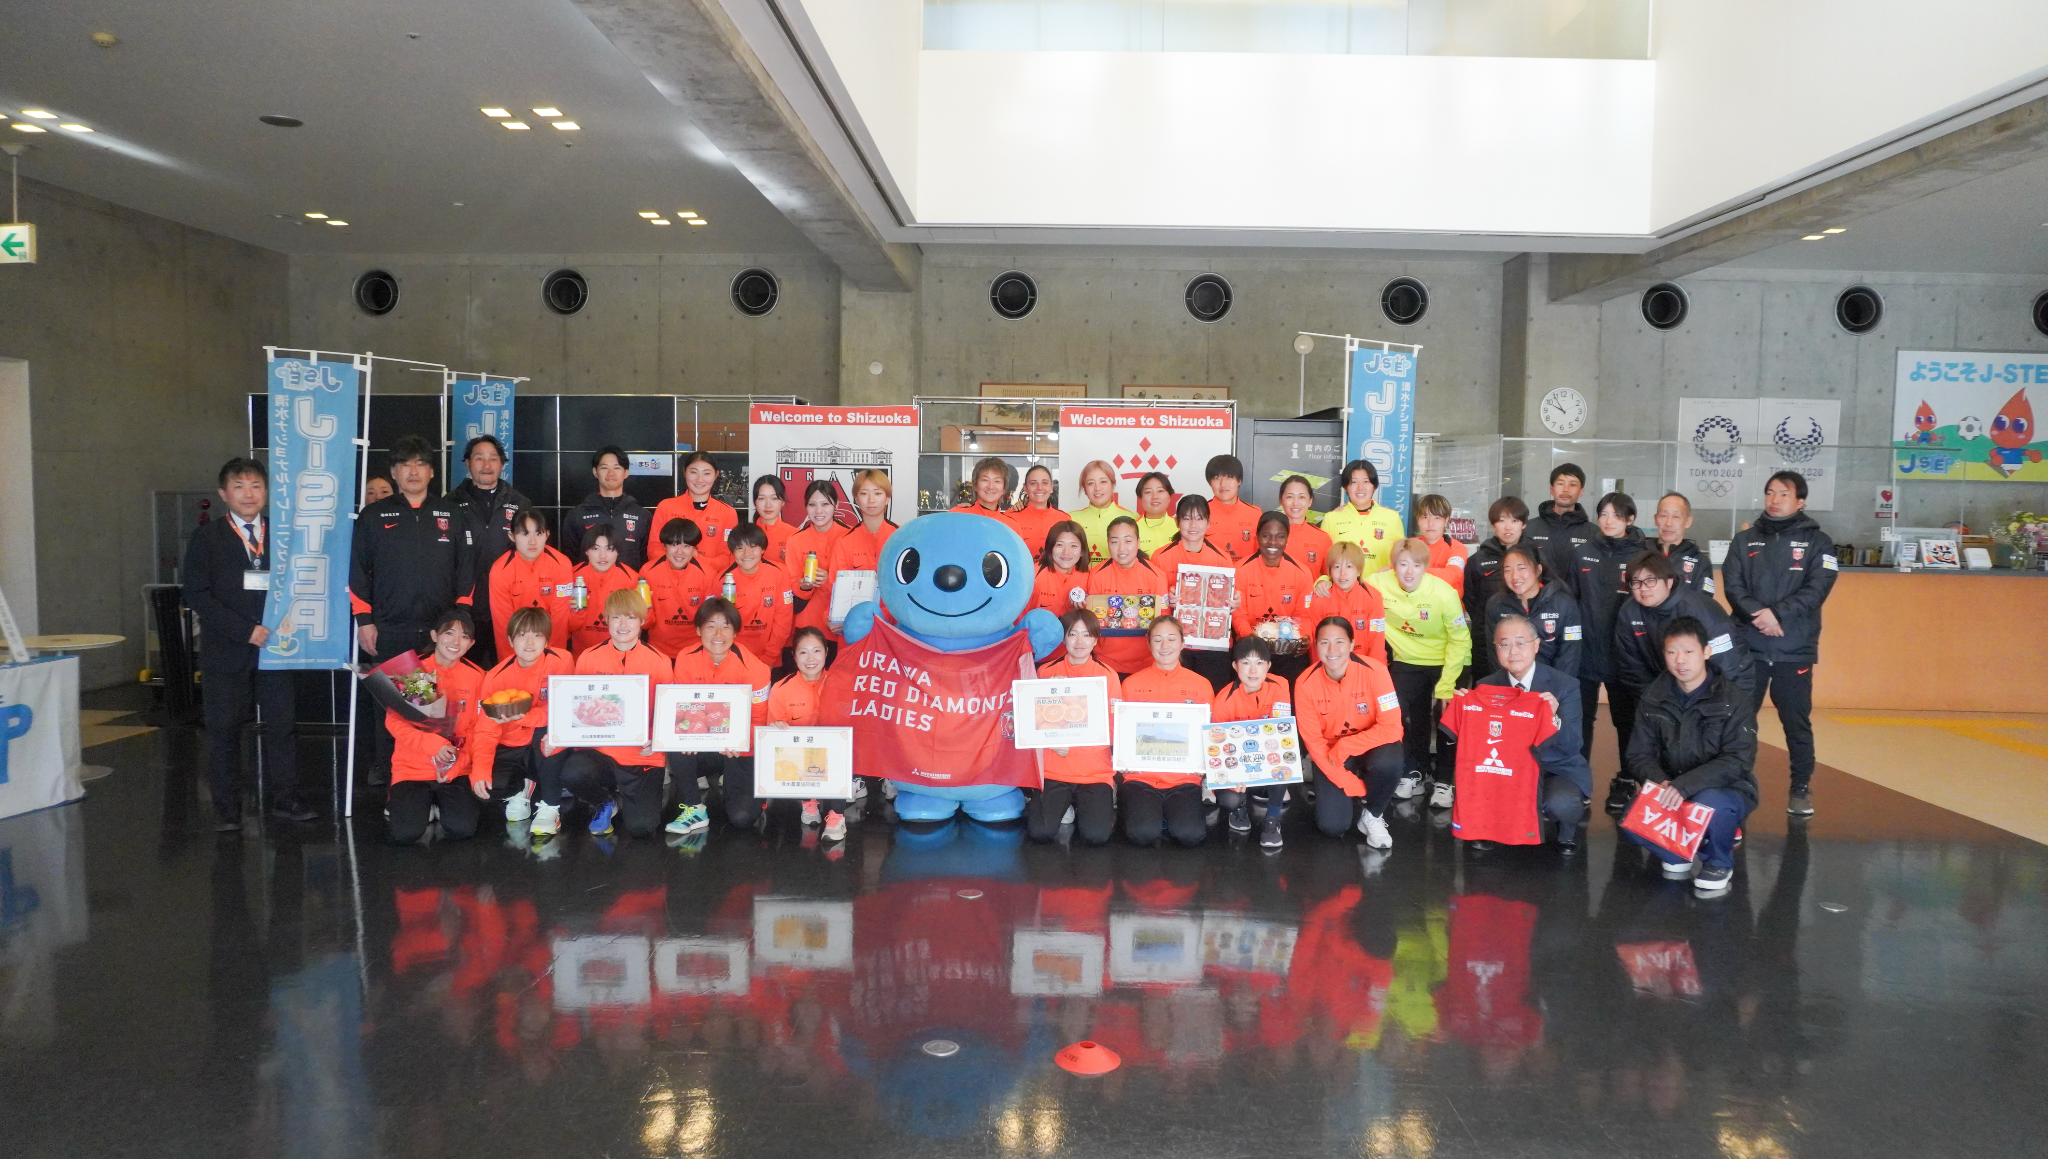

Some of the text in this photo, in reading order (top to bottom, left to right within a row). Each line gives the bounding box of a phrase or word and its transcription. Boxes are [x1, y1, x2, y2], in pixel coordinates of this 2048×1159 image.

[759, 410, 911, 424] Welcome to Shizuoka
[1070, 413, 1224, 427] Welcome to Shizuoka
[1690, 469, 1743, 478] TOKYO 2020
[1802, 468, 1823, 477] 2020
[858, 651, 931, 687] URAWA
[853, 675, 897, 697] RED
[850, 699, 934, 731] LADIES
